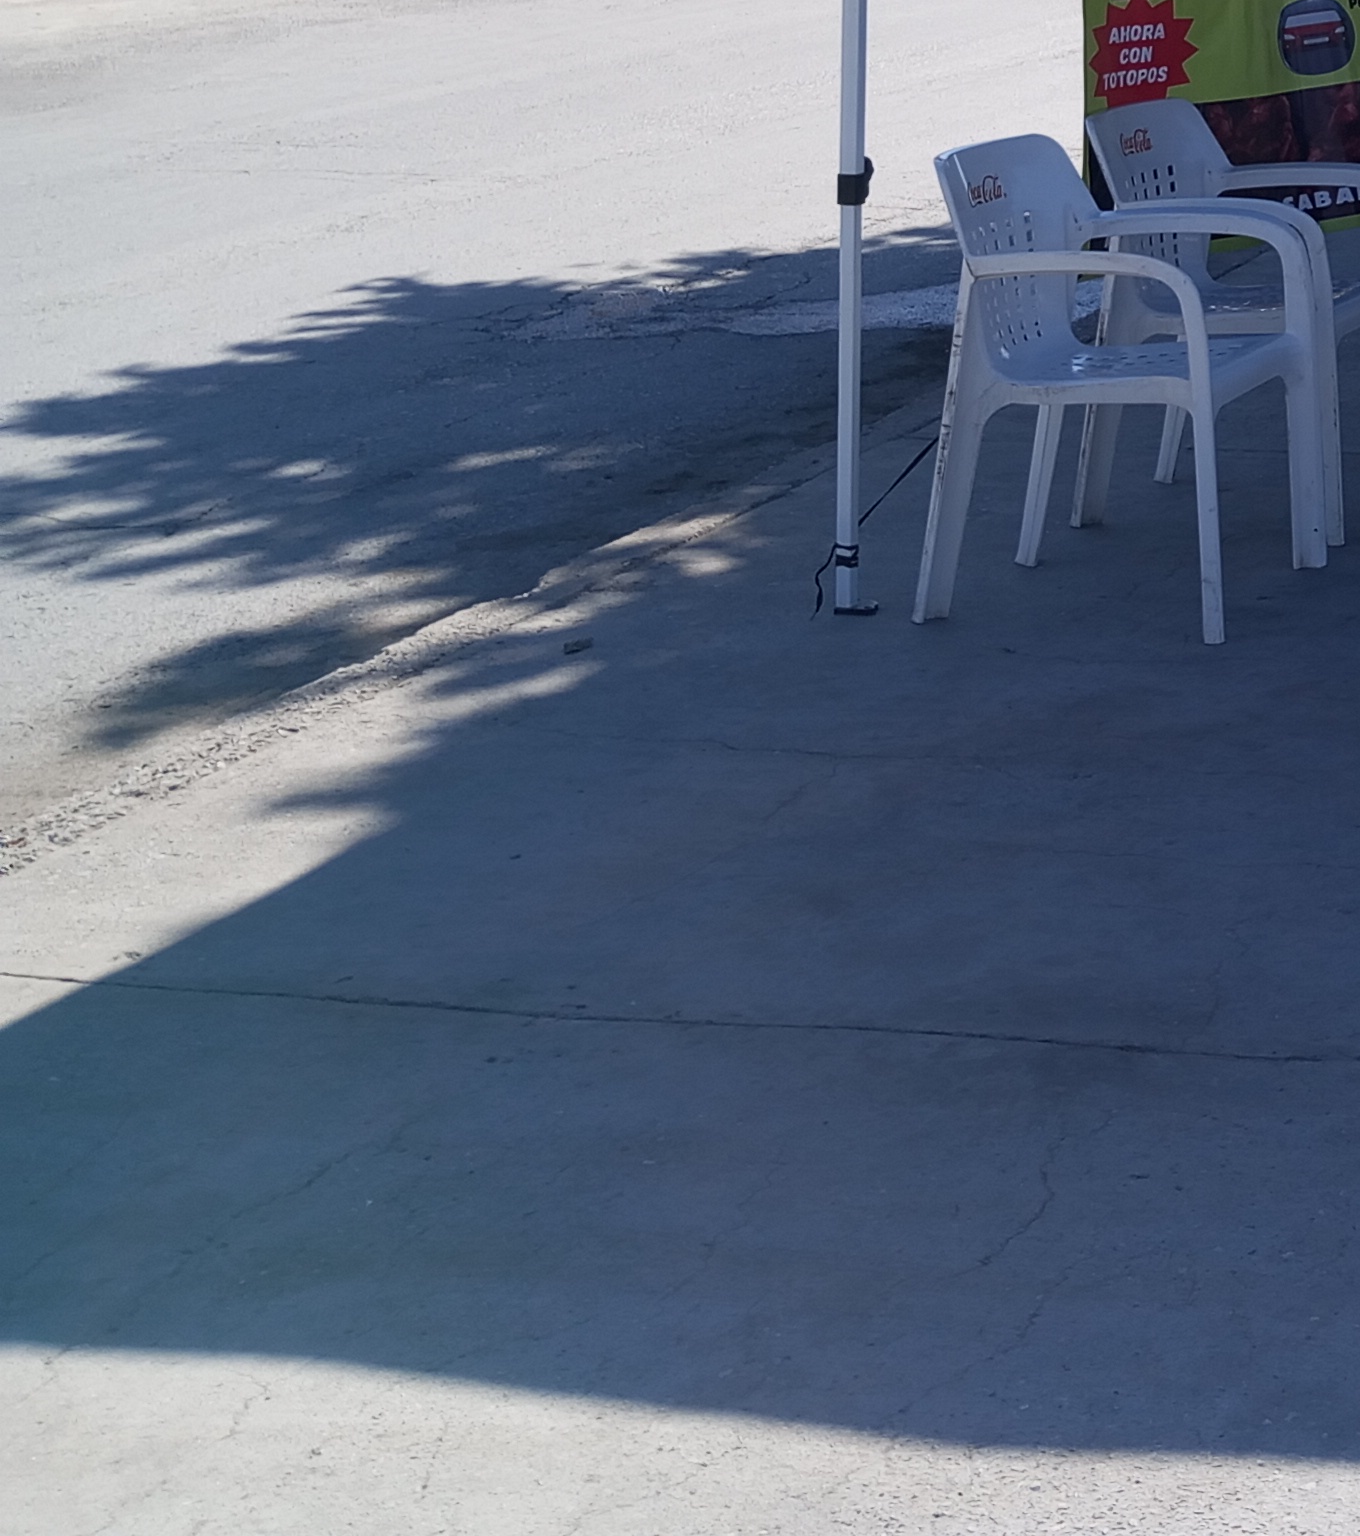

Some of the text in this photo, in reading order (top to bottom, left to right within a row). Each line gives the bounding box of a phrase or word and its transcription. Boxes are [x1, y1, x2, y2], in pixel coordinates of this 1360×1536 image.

[1109, 23, 1165, 45] AHORA
[1120, 46, 1153, 65] CON
[1103, 66, 1168, 91] TOTOPOS
